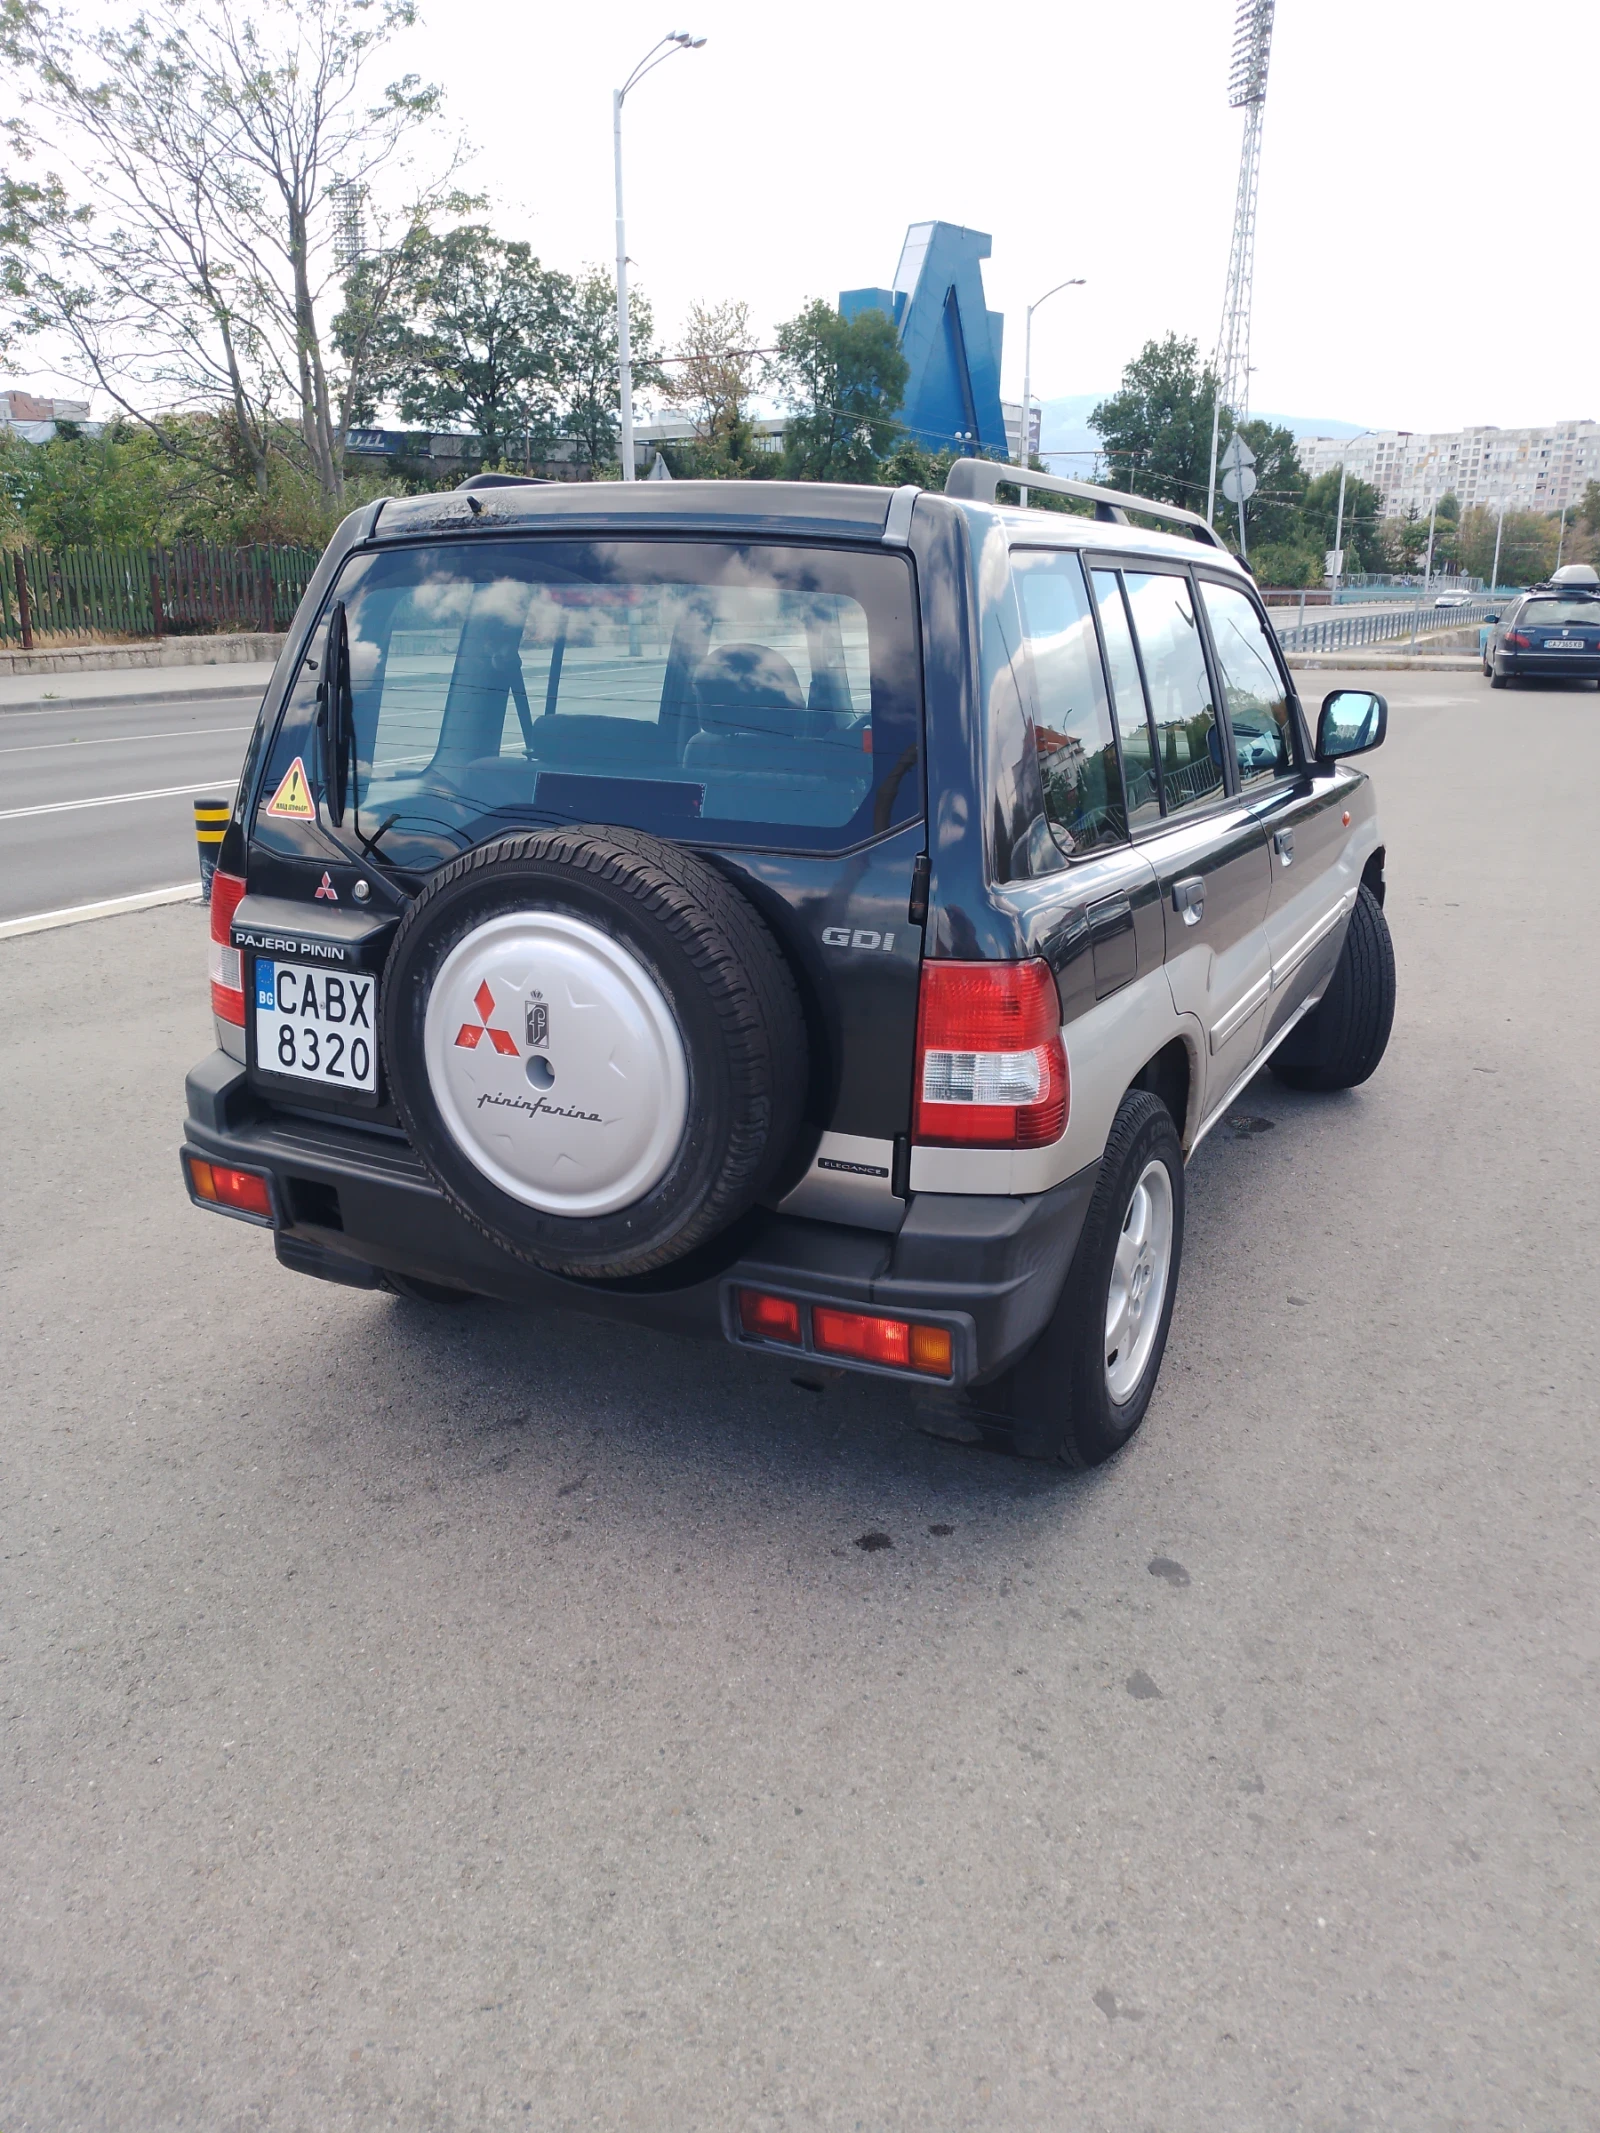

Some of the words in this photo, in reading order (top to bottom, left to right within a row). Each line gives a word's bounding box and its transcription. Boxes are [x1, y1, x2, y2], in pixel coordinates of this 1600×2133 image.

[235, 933, 297, 953] PAJERO
[300, 943, 345, 960] PININ
[821, 926, 896, 952] GDI
[259, 991, 274, 1006] BG
[276, 970, 371, 1029] CABX
[278, 1024, 370, 1082] 8320
[476, 1092, 603, 1122] pininfarina
[824, 1160, 882, 1175] ELEGANCE
